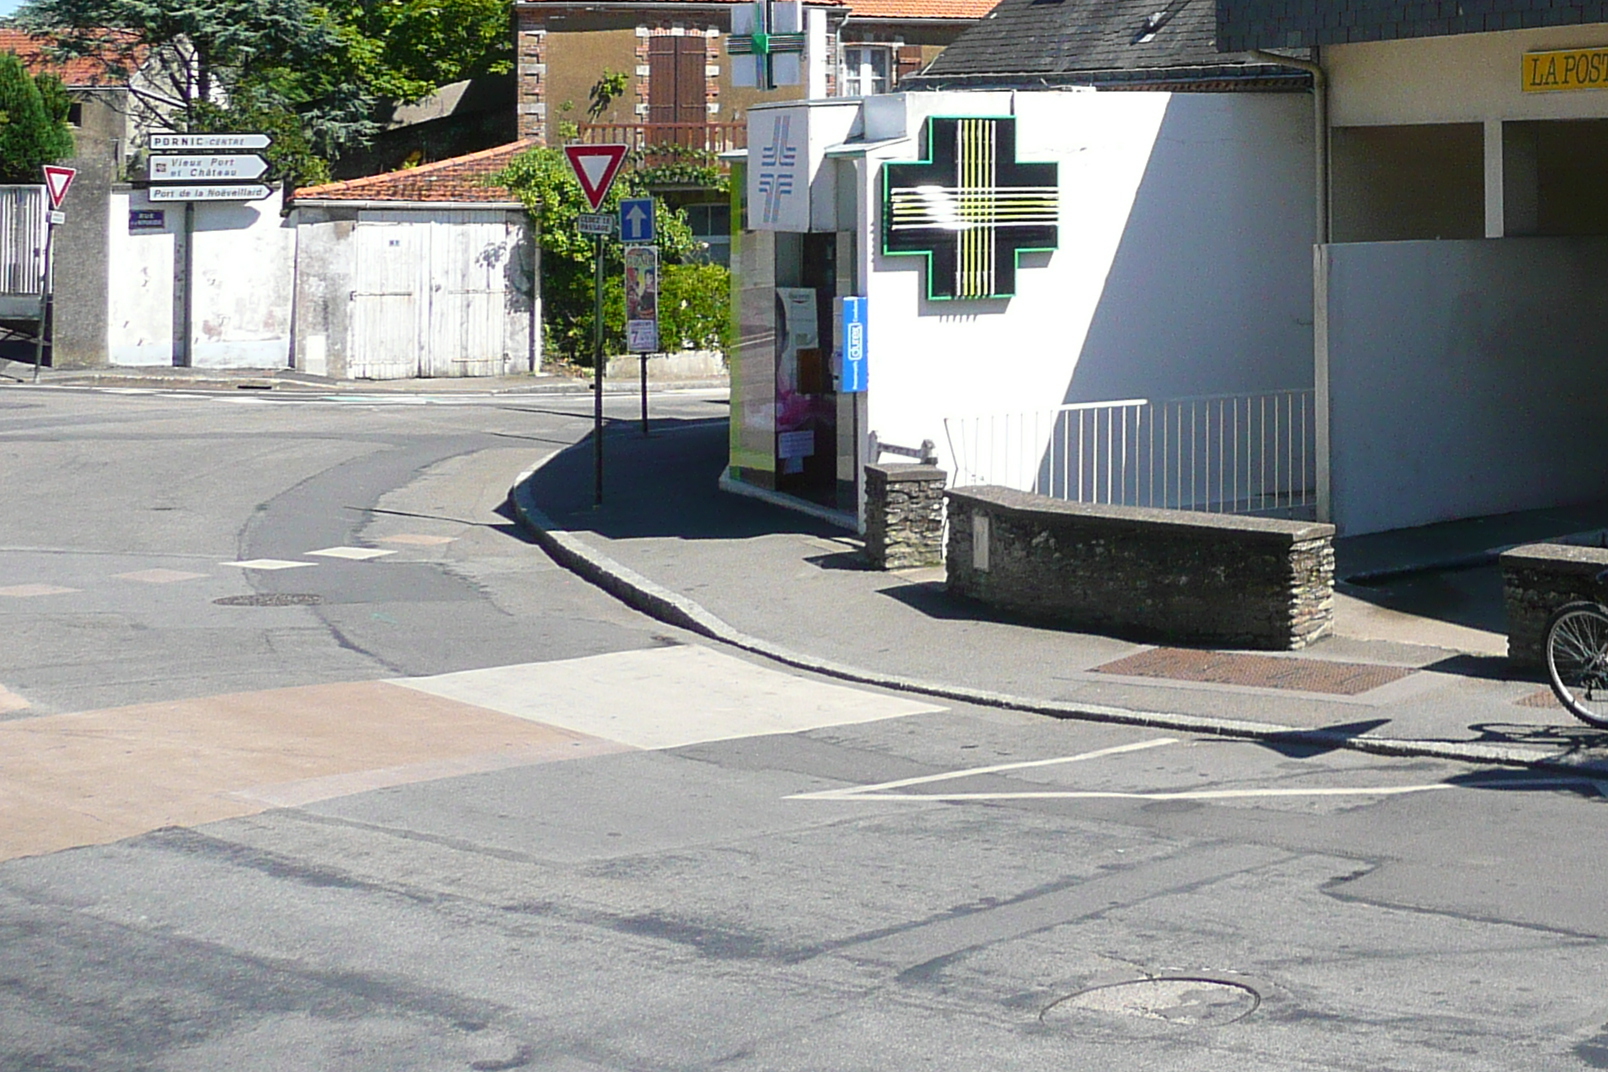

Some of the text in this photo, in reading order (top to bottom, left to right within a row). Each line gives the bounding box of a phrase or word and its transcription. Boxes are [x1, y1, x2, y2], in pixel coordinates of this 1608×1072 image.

[1530, 57, 1559, 86] LA
[154, 137, 245, 146] PORNIC CENTRE
[171, 158, 236, 167] Vieux Port
[190, 168, 237, 178] Château
[153, 189, 174, 198] Port
[179, 189, 191, 198] de
[195, 188, 204, 197] la
